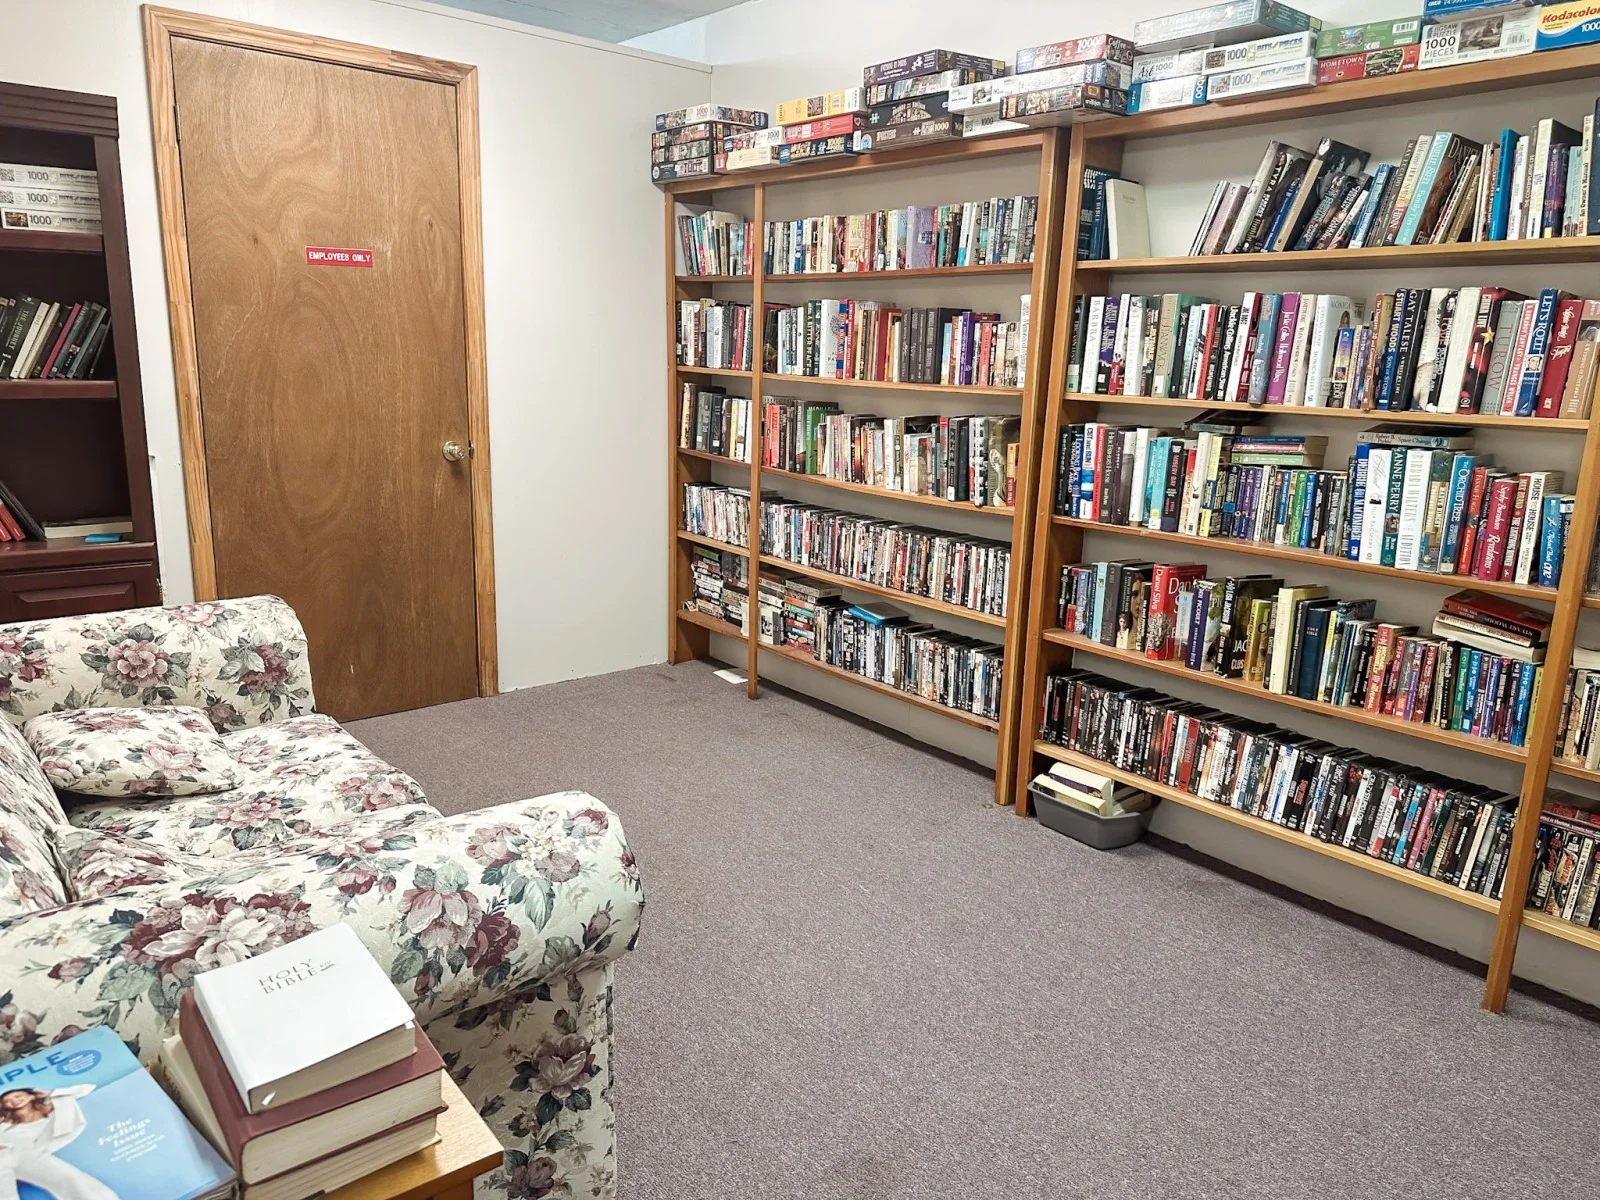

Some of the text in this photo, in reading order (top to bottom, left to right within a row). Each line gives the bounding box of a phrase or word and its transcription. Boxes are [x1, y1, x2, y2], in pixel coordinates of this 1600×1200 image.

[1433, 29, 1458, 38] PUZZLE
[1434, 23, 1458, 32] JIGSAW
[1582, 22, 1600, 32] 1000
[1226, 49, 1247, 60] 1000
[1424, 48, 1454, 58] PIECES
[1426, 36, 1456, 50] 1000
[1155, 62, 1174, 72] 1000
[1320, 56, 1364, 69] HOMETOWN
[1231, 75, 1250, 87] 1000
[934, 122, 949, 132] 1000
[1422, 134, 1448, 184] DANIELLE STEEL
[28, 171, 48, 181] 1000
[1266, 165, 1282, 192] TYRA
[27, 193, 48, 202] 1000
[1413, 190, 1426, 212] Family
[28, 215, 52, 225] 1000
[1390, 208, 1404, 228] HINN
[308, 252, 370, 262] EMPLOYEES ONLY
[1476, 294, 1492, 328] CHINA LIVE
[1538, 294, 1553, 321] LET'S
[1089, 300, 1101, 342] BARBRA
[1388, 292, 1404, 352] STUART WOODS
[1400, 290, 1418, 352] GAY TALESE
[1440, 317, 1448, 345] LOVE
[8, 323, 23, 350] JOURNEY
[1221, 350, 1232, 376] American
[1488, 324, 1512, 390] TUROW
[1086, 428, 1094, 440] CUT
[1170, 454, 1179, 476] MISERY
[1390, 453, 1404, 512] ANNE PERRY
[1455, 469, 1470, 503] ORCHID
[1470, 474, 1482, 512] FANNIE FLAGG
[1515, 478, 1528, 509] MAX BRAND
[1529, 477, 1542, 501] HOUSE
[1351, 458, 1368, 540] DEBBIE MACOMBER
[1404, 489, 1420, 522] WALTERS
[1494, 484, 1510, 530] Sophy Burnham
[1451, 502, 1461, 522] TREE
[1512, 517, 1520, 526] THE
[1524, 508, 1537, 531] HOUSE
[1485, 534, 1500, 569] Revelations
[1151, 568, 1163, 610] Daniel Silva
[1193, 599, 1203, 624] PICOULT
[1220, 600, 1232, 623] JACKSON
[1378, 797, 1395, 836] THE HATE GIVE
[1535, 869, 1551, 897] DEATH
[259, 958, 312, 986] HOLY
[263, 968, 318, 994] BIBLE
[98, 1118, 152, 1146] Feelings
[106, 1117, 134, 1132] The
[113, 1129, 148, 1148] Issue
